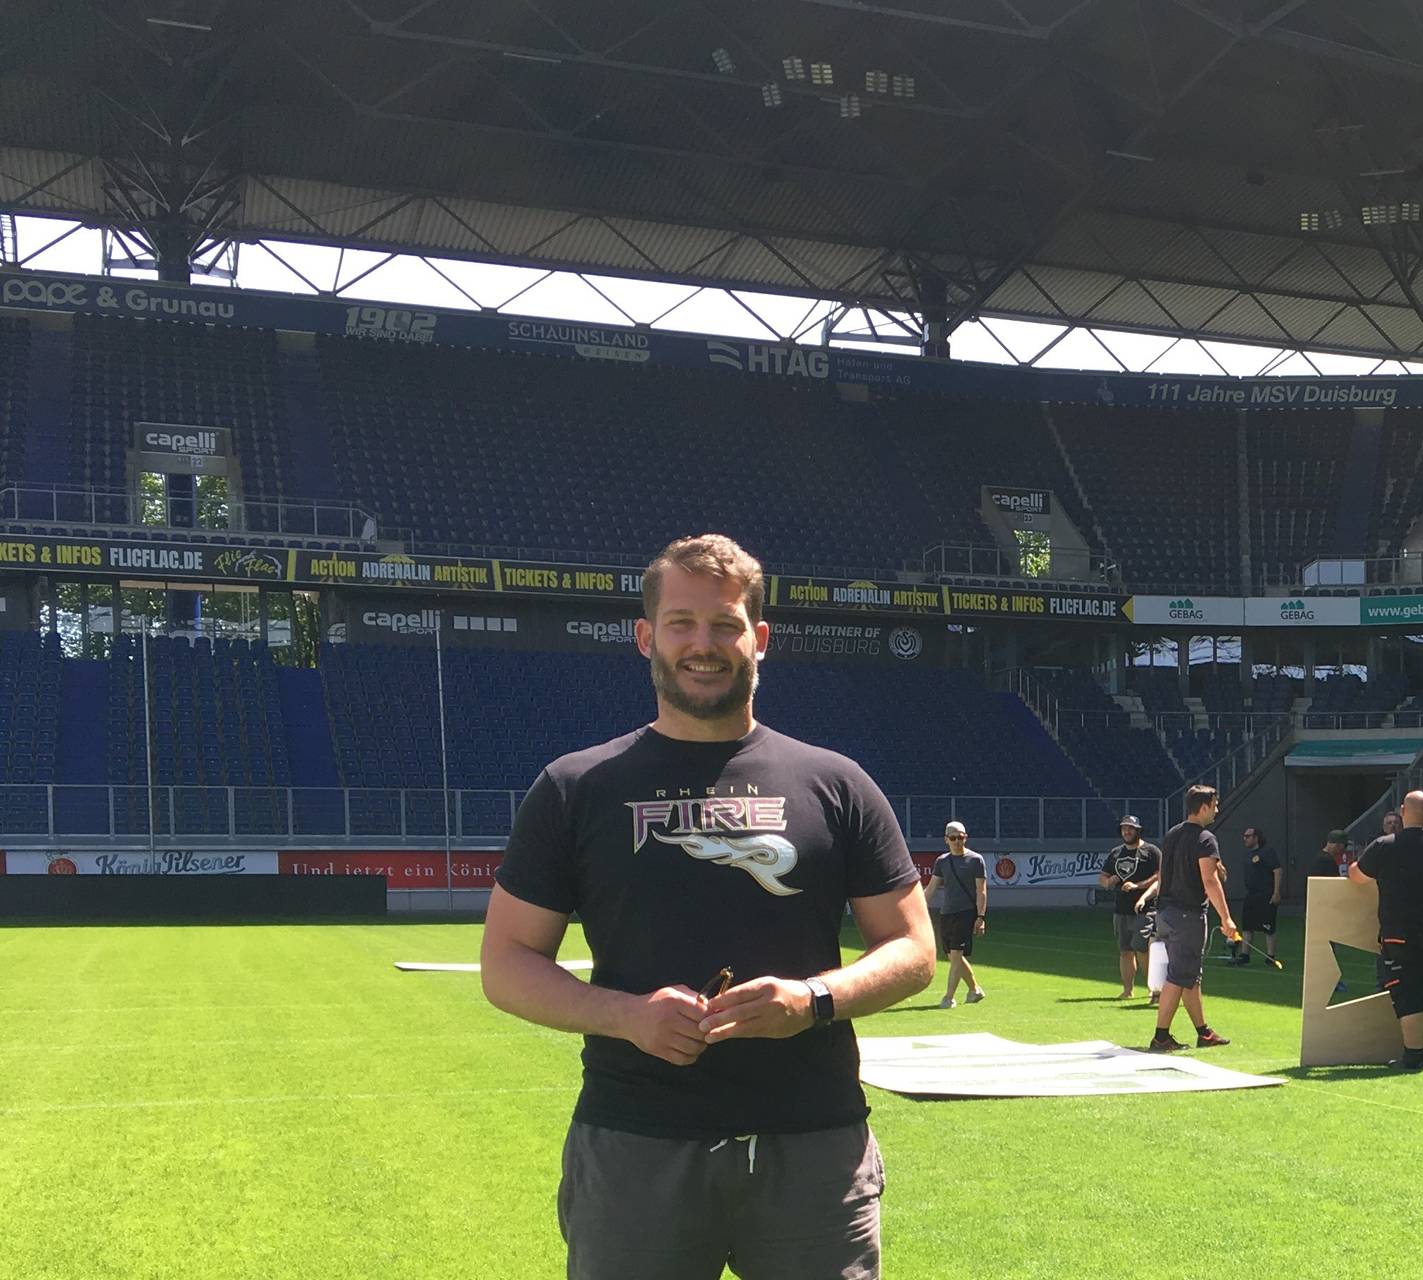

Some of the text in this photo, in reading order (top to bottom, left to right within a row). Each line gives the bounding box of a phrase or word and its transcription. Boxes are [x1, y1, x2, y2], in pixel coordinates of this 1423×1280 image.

[3, 279, 235, 318] pape & Grunau
[508, 322, 649, 348] SCHAUINSLAND
[748, 344, 829, 379] HTAG
[1149, 383, 1398, 405] 111 Jahre MSV Duisburg
[145, 432, 216, 450] capelli
[992, 493, 1043, 509] capelli
[0, 543, 203, 570] KETS & INFOS FLICFLAC.DE
[311, 559, 487, 583] ACTION ADRENALIN ARTISTIK
[505, 567, 557, 588] TICKETS
[562, 572, 571, 589] &
[576, 572, 613, 591] INFOS
[790, 585, 938, 607] ACTION ADRENALIN ARTISTIK
[953, 592, 1116, 616] TICKETS & INFOS FLICFLAC.DE
[363, 609, 440, 631] capelli
[1169, 609, 1203, 619] GEBAG
[1281, 611, 1314, 620] GEBAG
[770, 624, 880, 638] ICIAL PARTNER OF
[768, 636, 788, 650] SV
[791, 637, 880, 655] DUISBURG
[656, 784, 758, 797] RHEIN
[625, 797, 787, 854] FIRE
[162, 852, 245, 874] Pilsener
[404, 865, 434, 876] ein
[1027, 851, 1103, 876] König Pils
